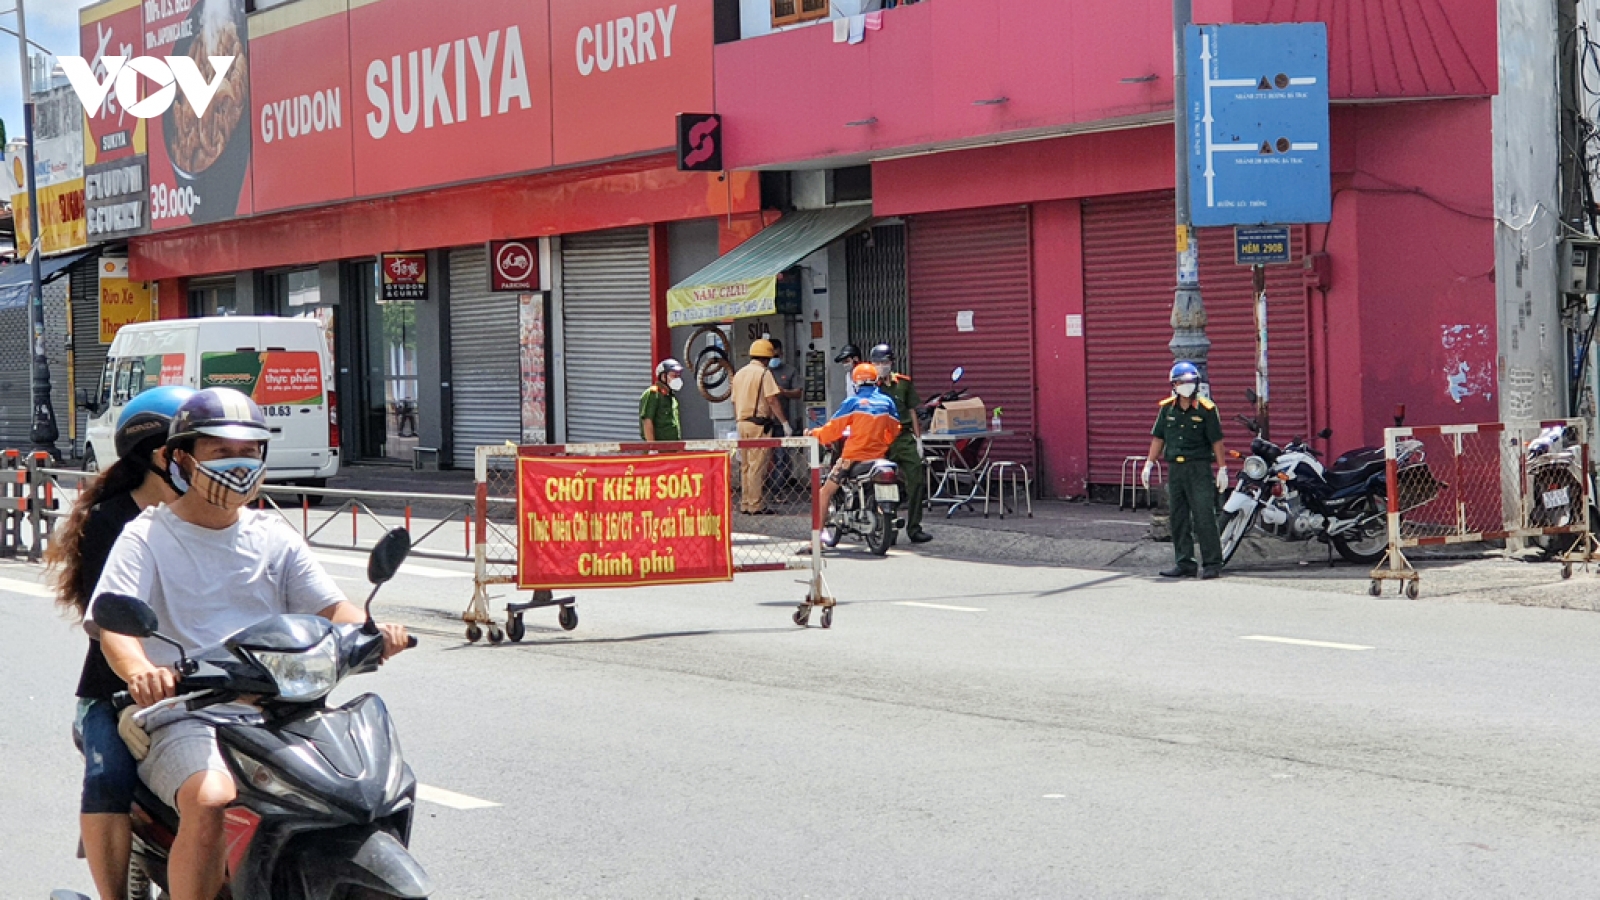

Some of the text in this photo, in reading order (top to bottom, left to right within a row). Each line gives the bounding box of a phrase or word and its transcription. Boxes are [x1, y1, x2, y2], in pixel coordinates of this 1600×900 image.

[575, 4, 678, 77] CURRY
[365, 25, 532, 140] SUKIYA
[260, 87, 342, 143] GYUDON
[86, 165, 143, 201] GYUDON
[121, 287, 134, 305] Xe
[501, 281, 530, 289] PARKING
[545, 464, 704, 502] CHỐT KIỂM SOÁT
[527, 512, 550, 548] Thực
[552, 512, 571, 548] hiện
[573, 510, 588, 541] Chỉ
[590, 512, 603, 548] thị
[605, 511, 634, 541] 16/CT
[661, 506, 676, 538] của
[677, 504, 695, 537] Thủ
[578, 547, 676, 579] Chính phủ
